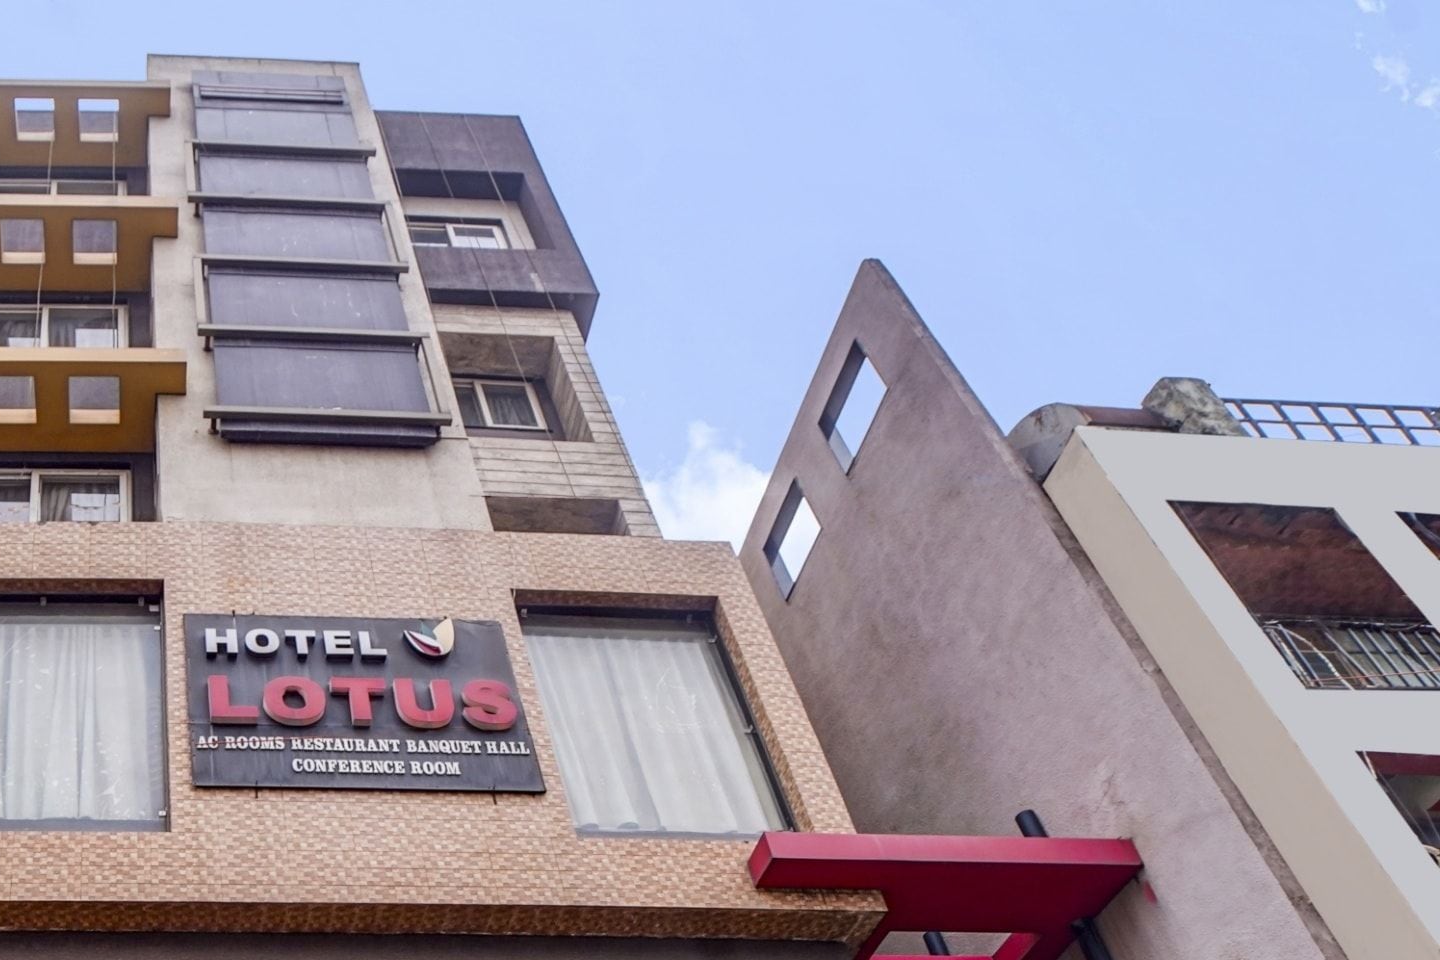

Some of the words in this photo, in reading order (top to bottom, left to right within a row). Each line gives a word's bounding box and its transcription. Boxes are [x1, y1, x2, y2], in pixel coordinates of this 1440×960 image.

[205, 628, 388, 660] HOTEL
[207, 675, 517, 730] LOTUS
[196, 735, 219, 749] AC
[224, 736, 286, 750] ROOMS
[291, 737, 400, 753] RESTAURANT
[406, 739, 481, 755] BANQUET
[486, 741, 530, 756] HALL
[292, 758, 406, 775] CONFERENCE
[410, 760, 462, 776] ROOM
